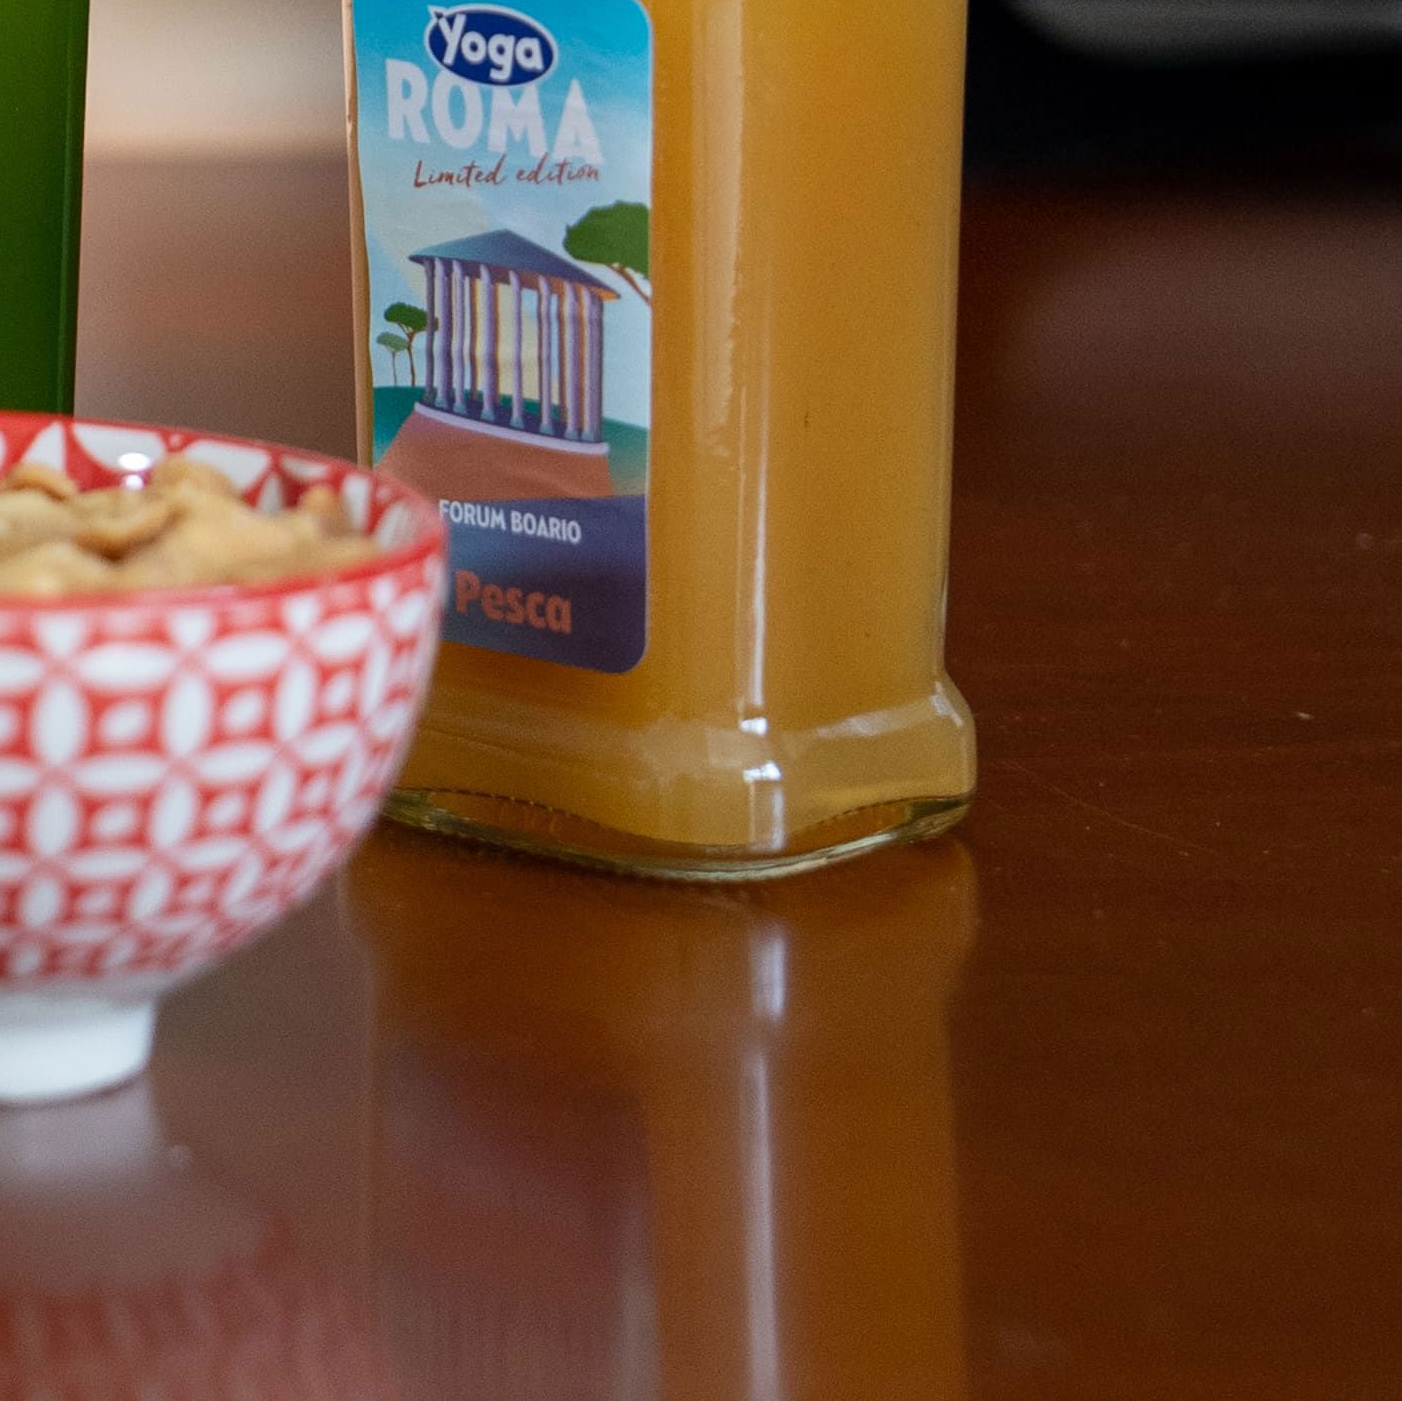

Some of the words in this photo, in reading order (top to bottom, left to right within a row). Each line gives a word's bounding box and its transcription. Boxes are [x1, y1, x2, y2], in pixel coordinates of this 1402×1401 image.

[438, 13, 545, 82] Yoga
[385, 58, 605, 165] ROMA
[413, 153, 508, 189] Limited
[515, 152, 600, 185] edition
[438, 499, 507, 530] FORUM
[511, 512, 582, 545] BOARIO
[454, 570, 573, 635] Pesca
